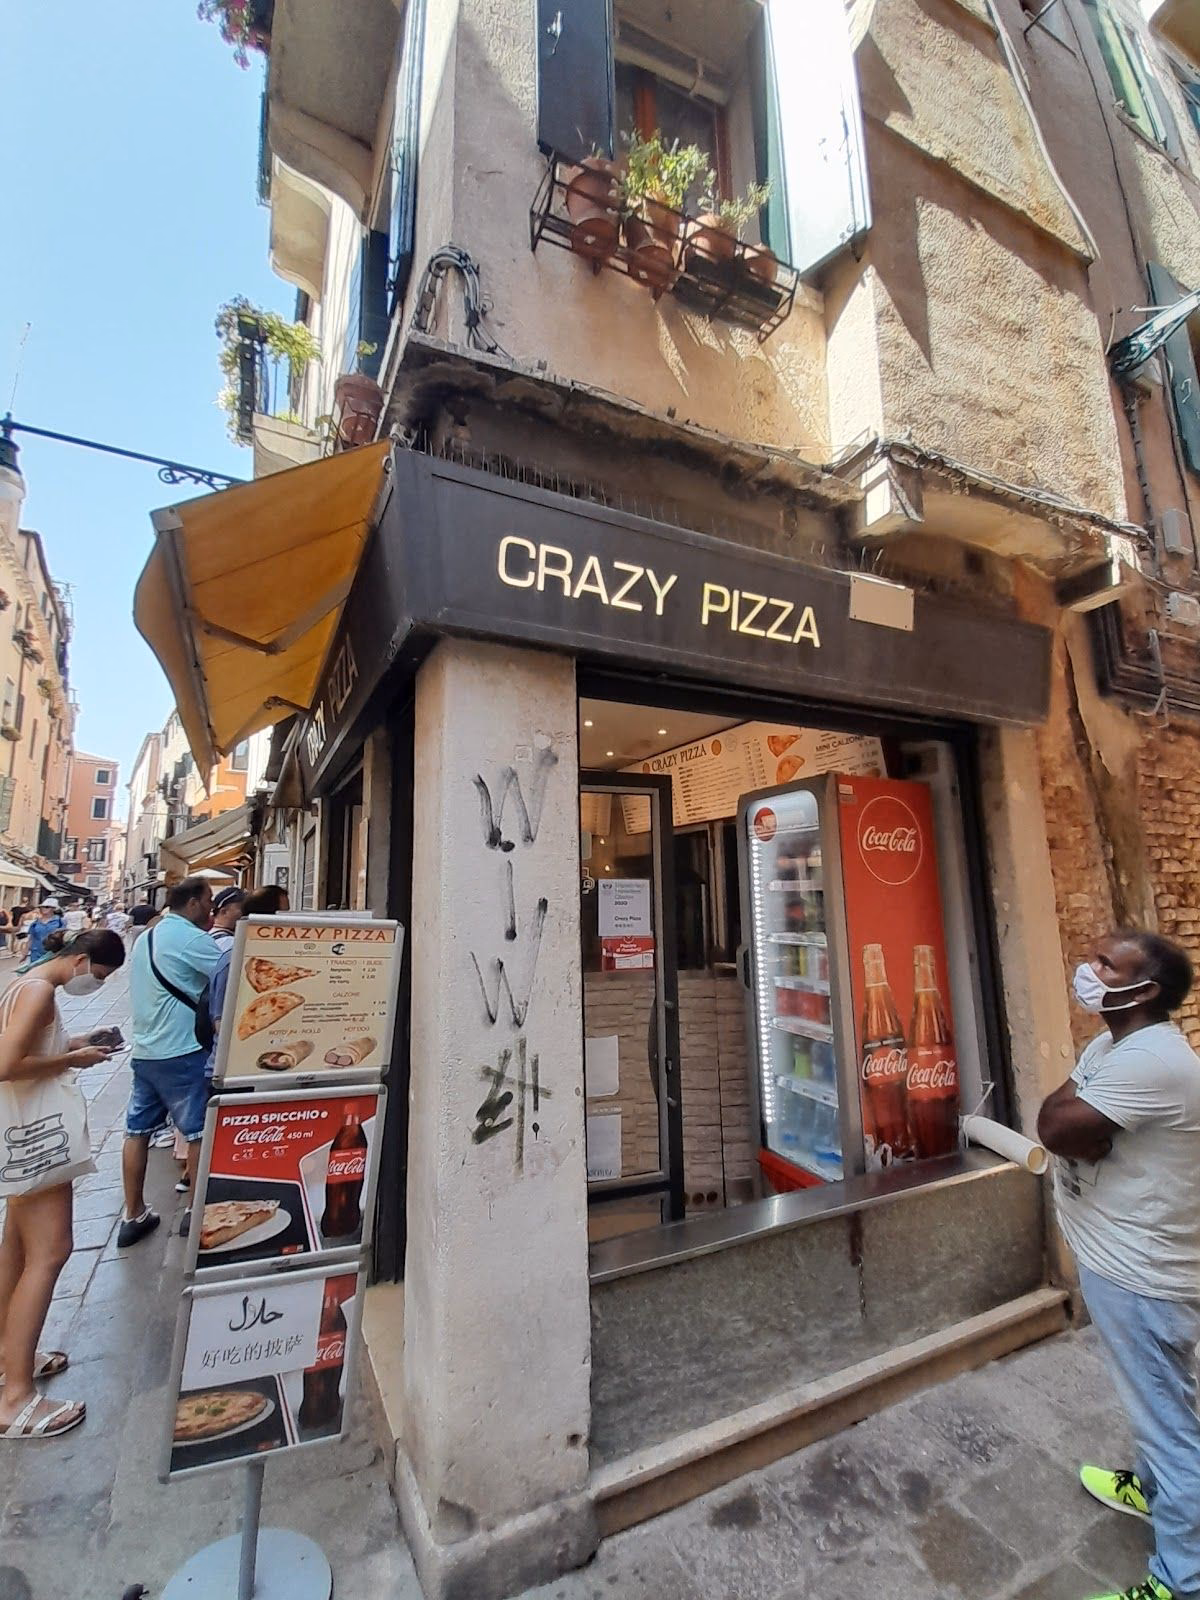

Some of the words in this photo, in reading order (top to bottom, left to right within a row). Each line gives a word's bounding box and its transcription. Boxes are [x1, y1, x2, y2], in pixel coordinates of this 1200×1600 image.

[498, 536, 678, 616] CRAZY
[702, 582, 820, 648] PIZZA
[652, 753, 678, 772] CRAZY
[680, 744, 707, 763] PIZZA
[816, 744, 830, 752] MINI
[862, 826, 916, 852] Coca-Cola
[257, 926, 326, 940] CRAZY
[333, 929, 386, 941] PIZZA
[862, 1049, 908, 1080] Coca-Cola
[906, 1060, 956, 1090] Coca-Cola
[222, 1114, 259, 1127] PIZZA
[261, 1109, 319, 1124] SPICCHIO
[233, 1125, 288, 1146] Coca-Cola
[287, 1131, 302, 1140] 450
[302, 1130, 314, 1139] ml
[229, 1296, 284, 1332] حلال
[202, 1334, 304, 1369] 好吃的披萨
